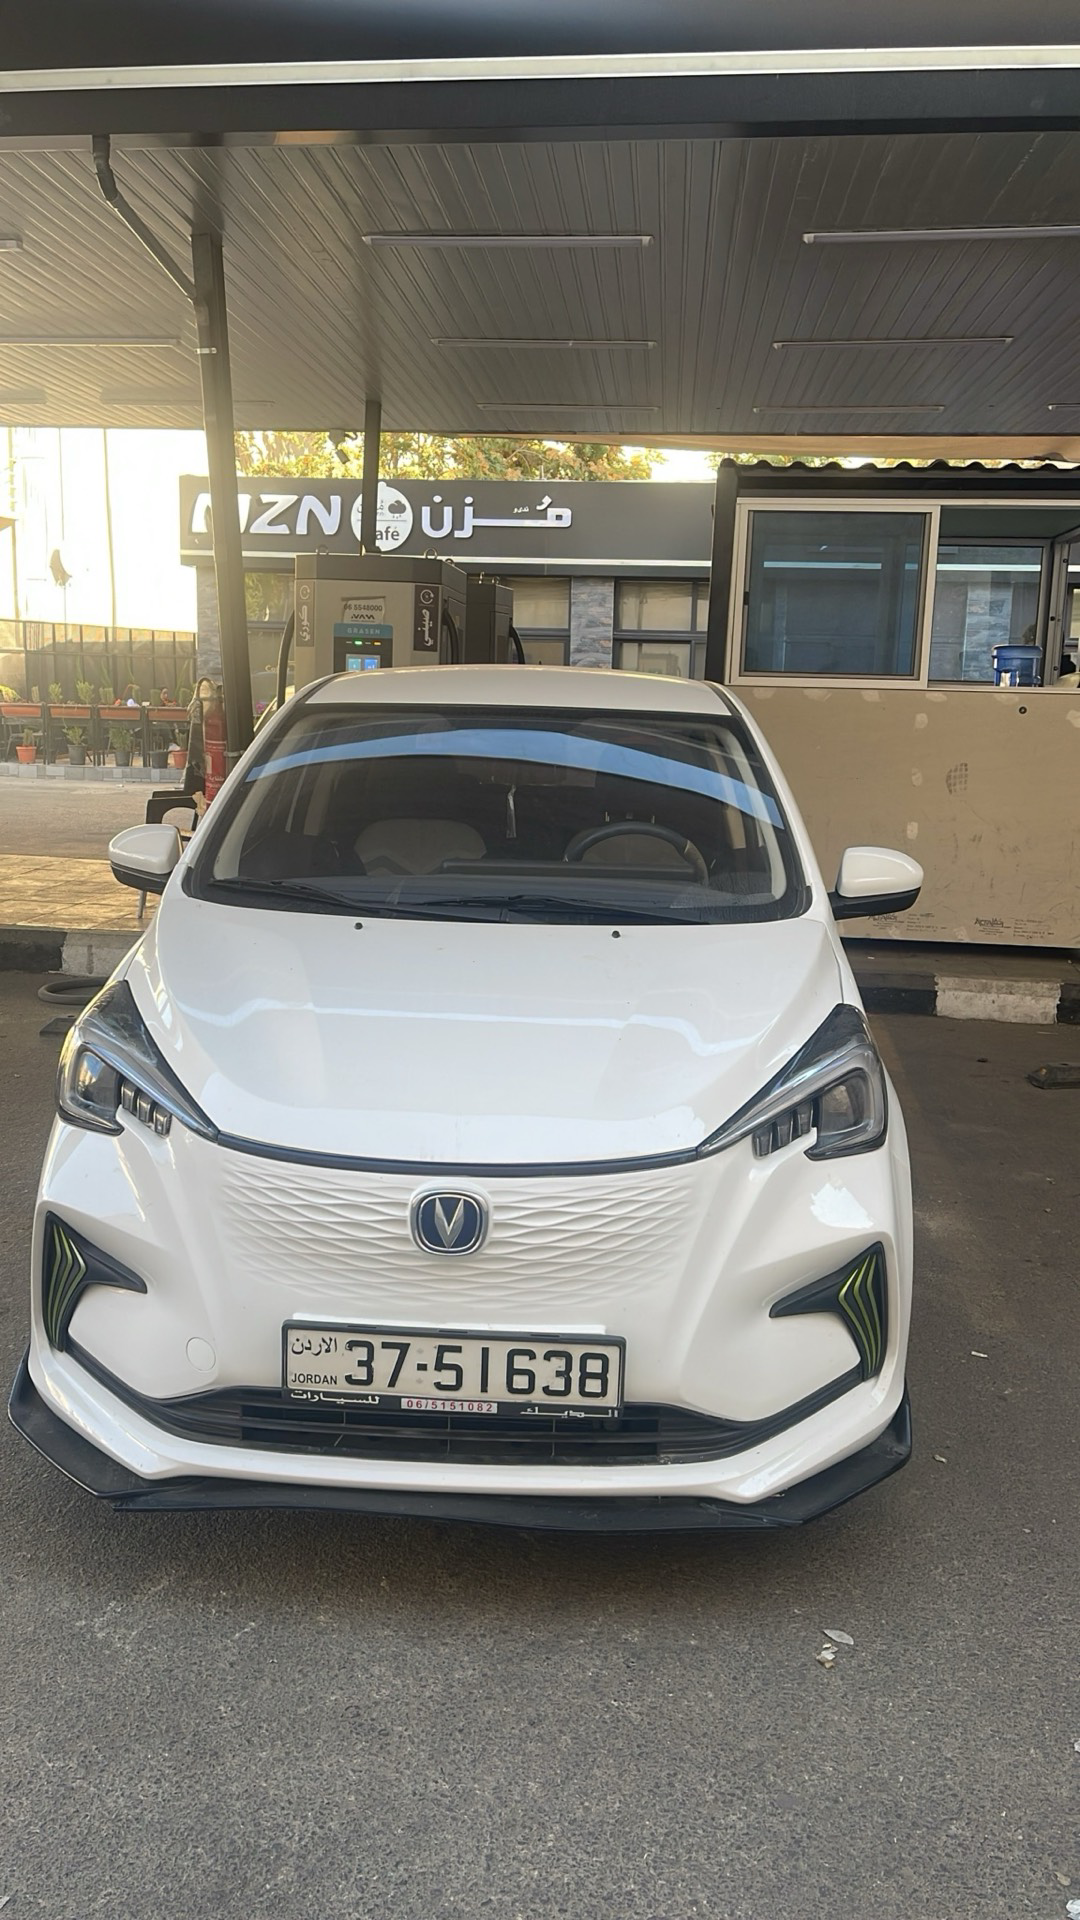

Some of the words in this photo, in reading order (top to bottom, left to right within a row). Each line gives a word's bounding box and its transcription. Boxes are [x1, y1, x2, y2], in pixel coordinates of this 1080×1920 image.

[376, 526, 400, 541] afé
[417, 609, 434, 647] صيني
[291, 1337, 338, 1356] الاردن
[291, 1373, 338, 1385] JORDAN
[290, 1391, 380, 1404] للسيارات
[406, 1399, 493, 1412] 06/5151082
